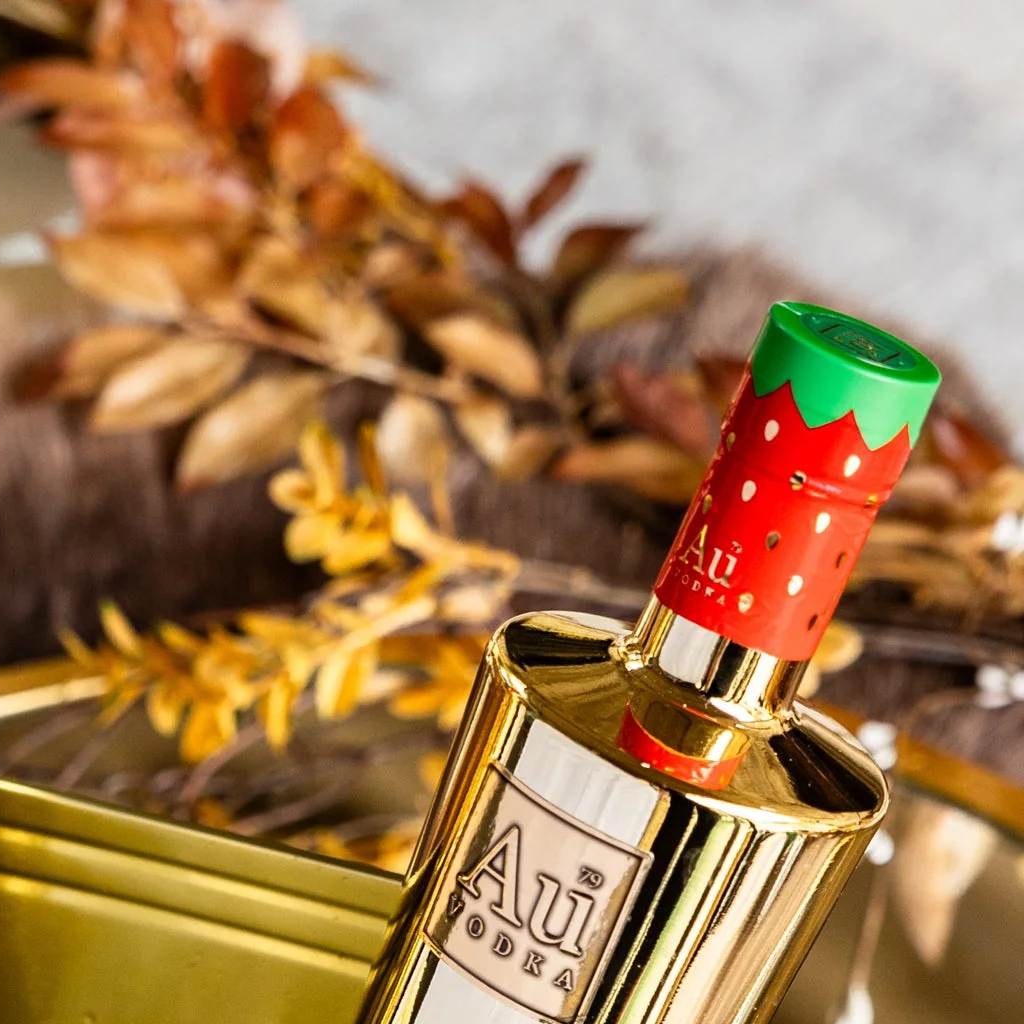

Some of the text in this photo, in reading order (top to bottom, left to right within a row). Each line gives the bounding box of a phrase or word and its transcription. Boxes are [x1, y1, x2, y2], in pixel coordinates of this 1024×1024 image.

[678, 524, 737, 588] Au
[457, 824, 595, 957] Au
[578, 867, 604, 889] 79
[447, 893, 575, 992] VODKA
